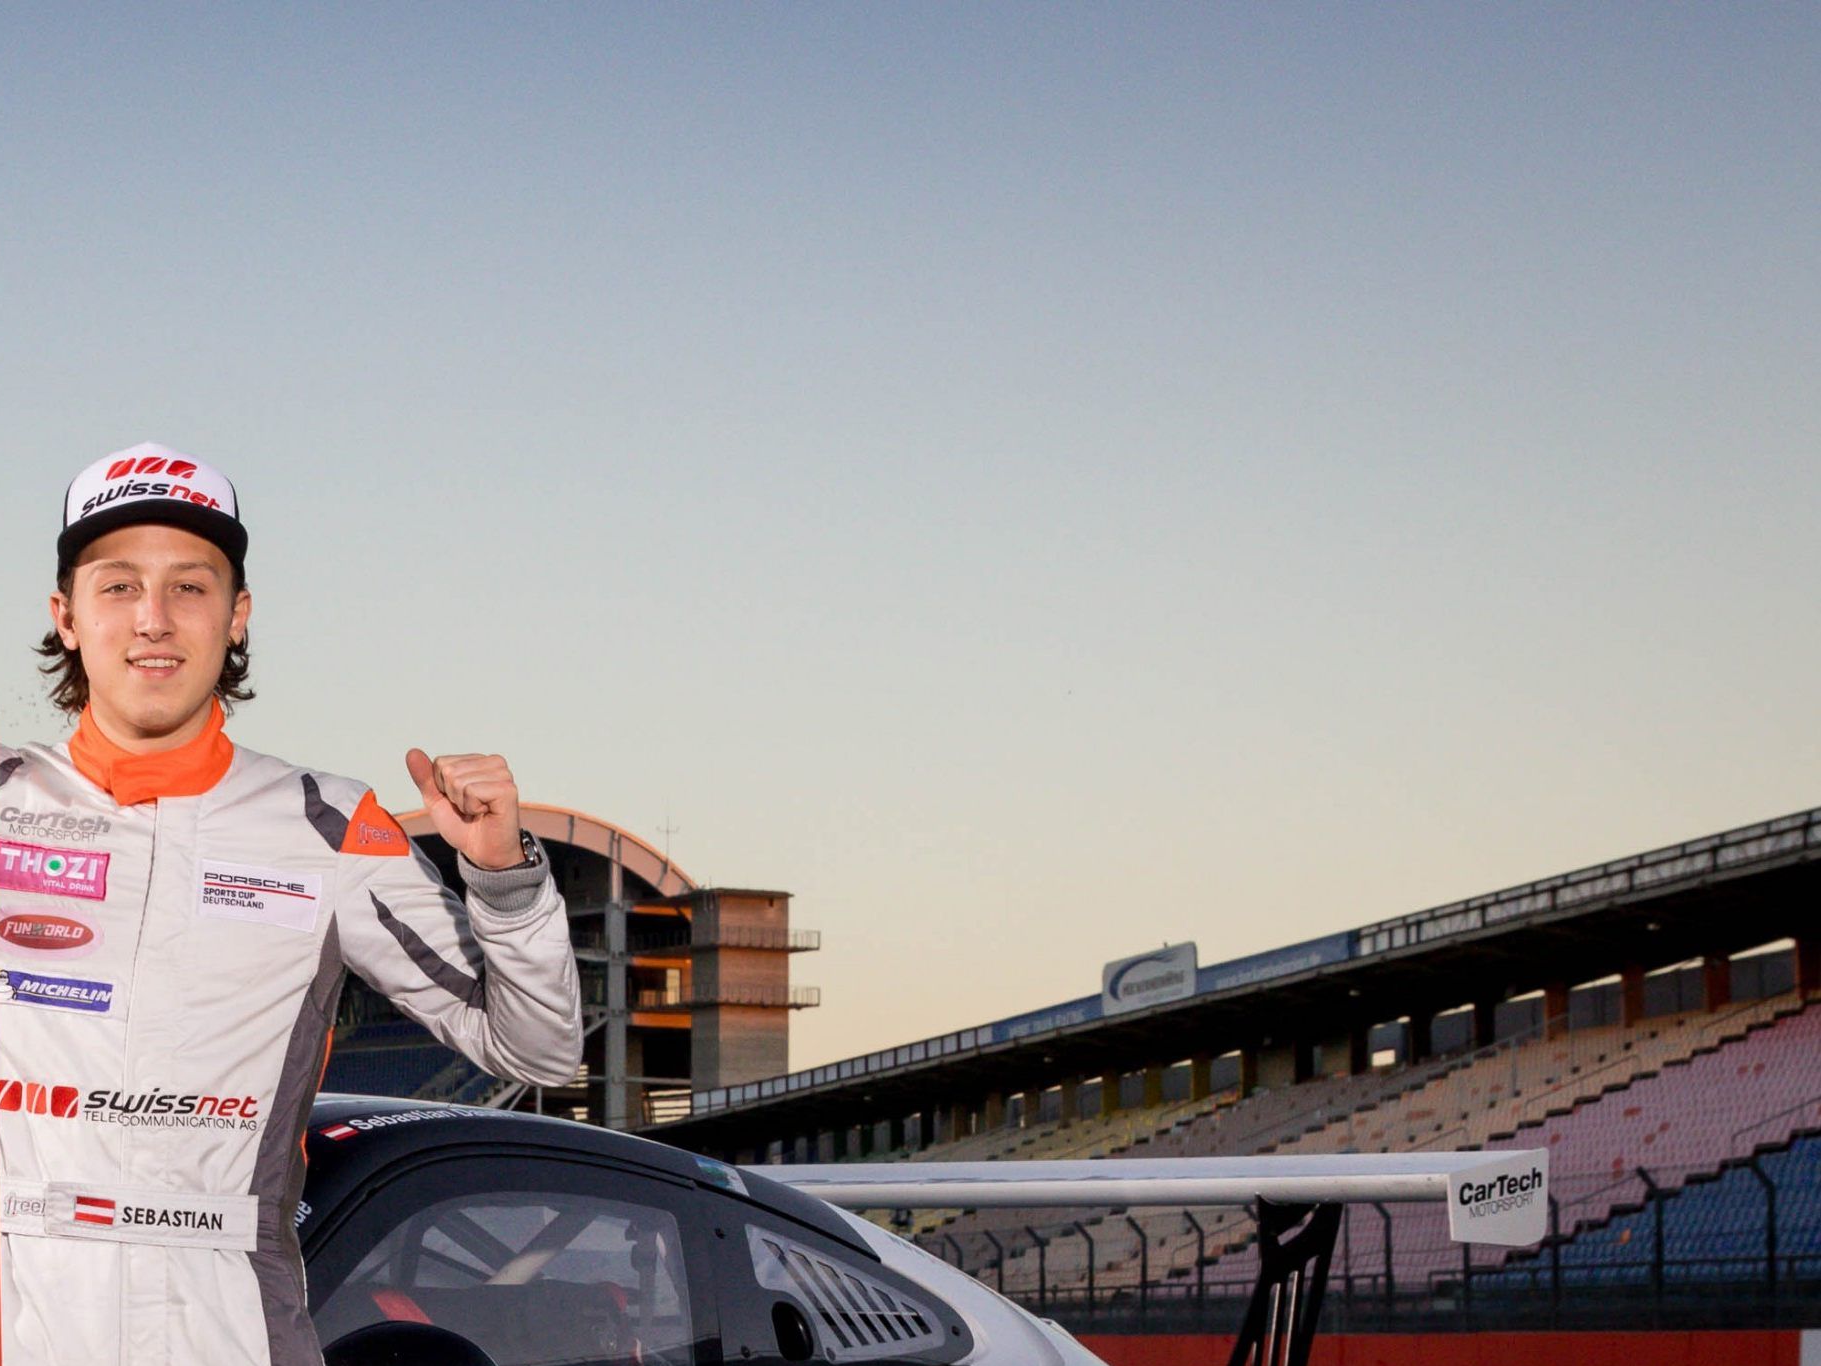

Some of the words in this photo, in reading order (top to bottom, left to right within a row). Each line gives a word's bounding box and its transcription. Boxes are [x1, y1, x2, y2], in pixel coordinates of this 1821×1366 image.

[80, 480, 221, 519] swissnet
[0, 806, 112, 834] CarTech
[8, 823, 98, 843] MOTORSPORT
[0, 847, 98, 881] THOZI
[42, 879, 66, 889] VITAL
[69, 881, 95, 893] DRINK
[203, 872, 305, 893] PORSCHE
[203, 887, 237, 899] SPORTS
[238, 890, 256, 899] CUP
[202, 896, 265, 910] DEUTSCHLAND
[19, 980, 113, 1003] MICHELIN
[84, 1087, 259, 1118] swissnet
[84, 1110, 236, 1130] TELECOMMUNICATION
[239, 1119, 258, 1131] AG
[348, 1108, 454, 1131] Sebastian
[1459, 1166, 1542, 1206] CarTech
[1469, 1191, 1535, 1219] MOTORSPORT
[121, 1206, 223, 1231] SEBASTIAN
